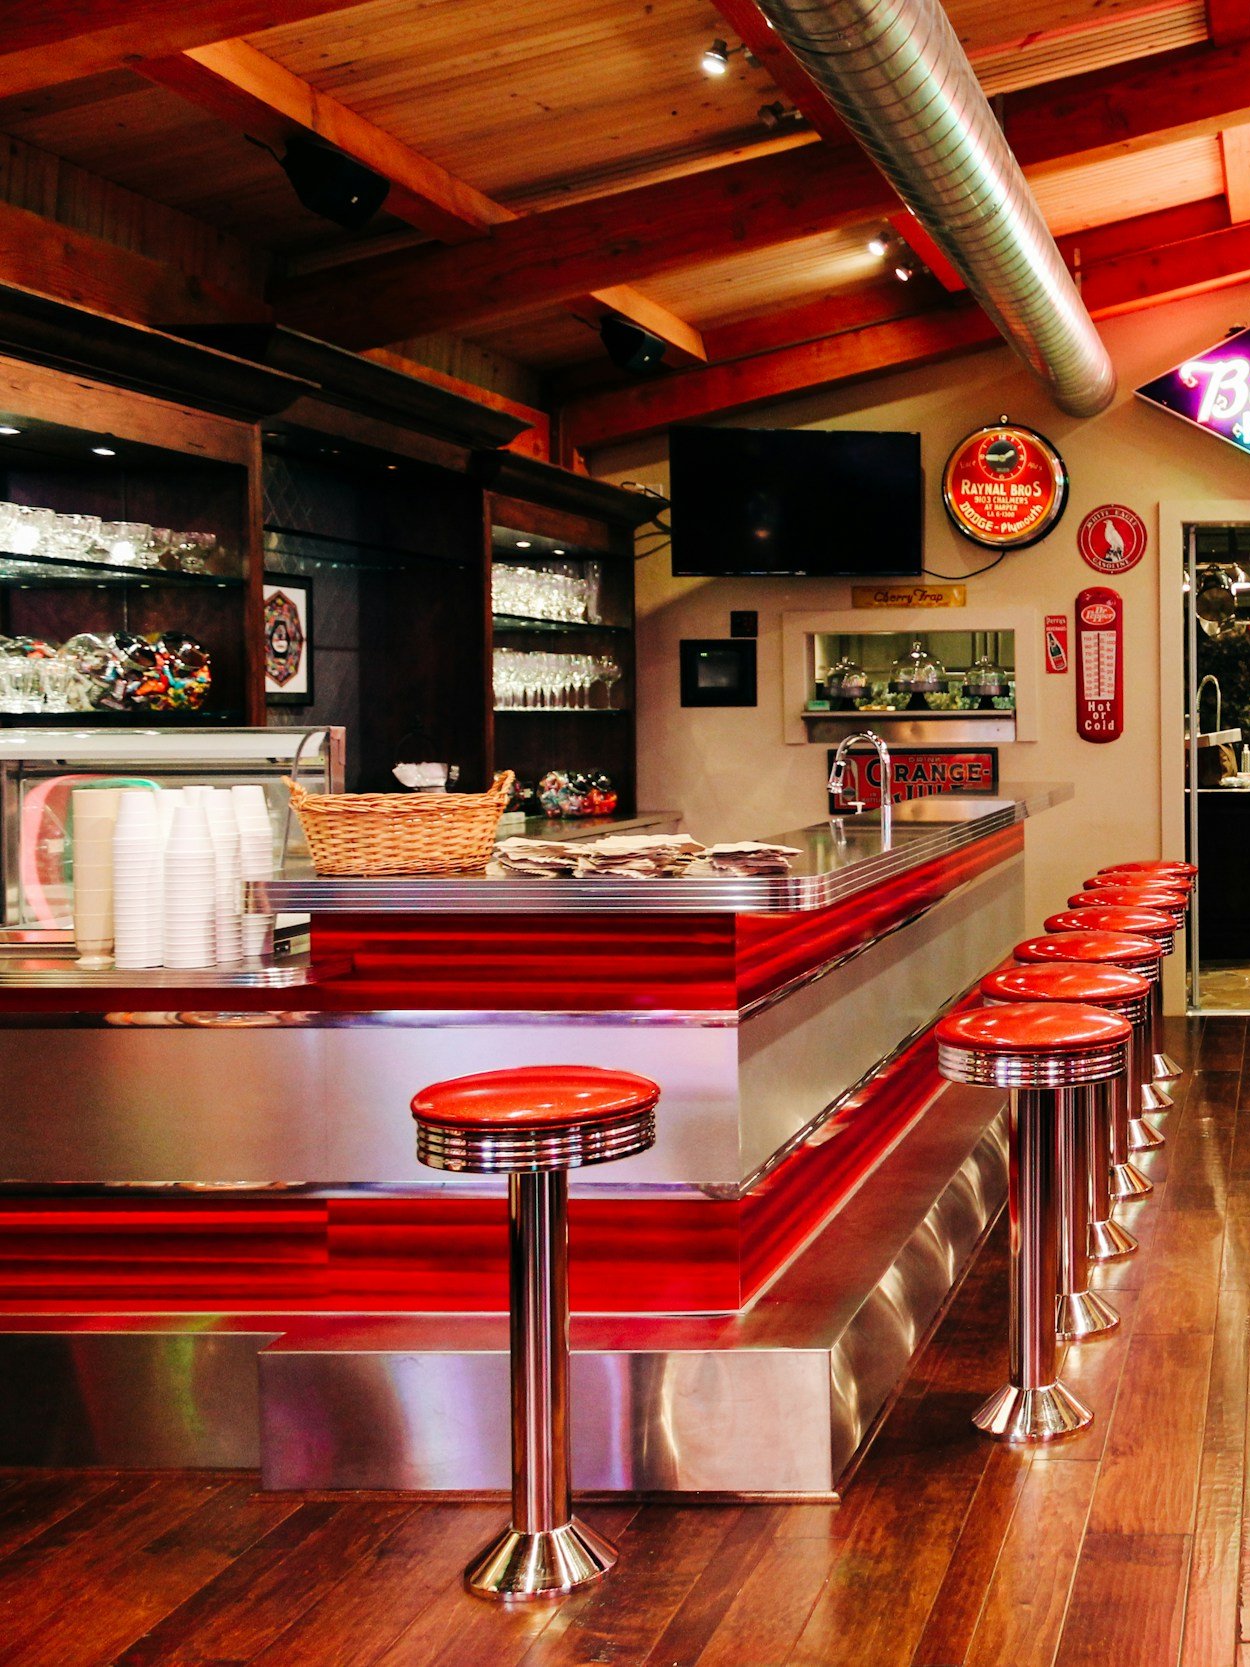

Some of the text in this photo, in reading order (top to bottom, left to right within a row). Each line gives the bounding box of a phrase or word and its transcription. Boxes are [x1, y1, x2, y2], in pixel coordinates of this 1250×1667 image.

[961, 479, 1006, 496] RAYNAL
[959, 501, 994, 532] DODGE
[1000, 503, 1044, 533] Plymouth
[874, 591, 913, 604] Cherry
[1086, 610, 1114, 623] Pepper
[1088, 701, 1111, 712] Hot
[1093, 711, 1106, 721] or
[1085, 720, 1114, 731] Cold
